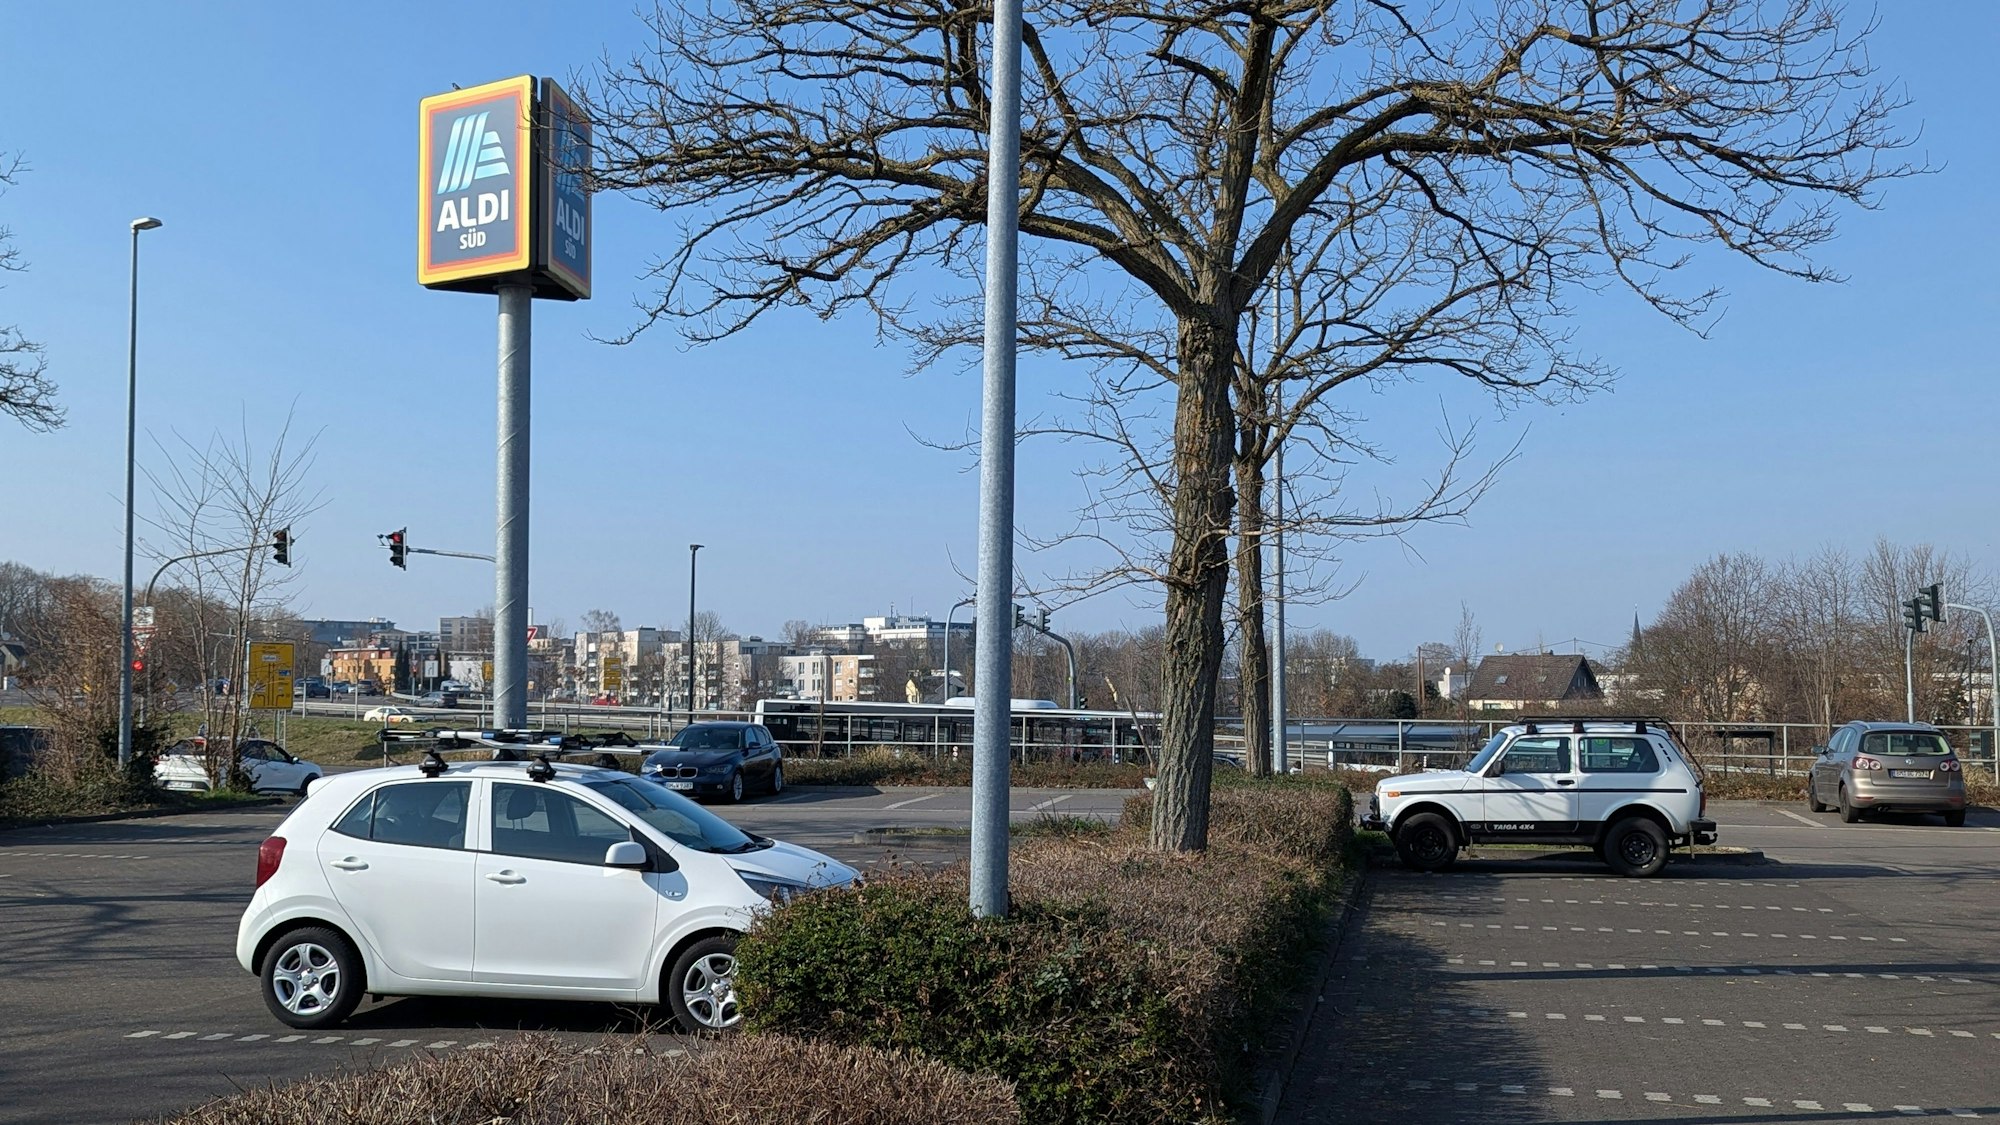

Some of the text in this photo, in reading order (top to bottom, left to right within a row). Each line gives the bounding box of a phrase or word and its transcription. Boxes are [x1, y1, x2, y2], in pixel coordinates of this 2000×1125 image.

[437, 189, 509, 232] ALDI
[556, 197, 585, 246] ALDI
[459, 228, 487, 250] SÜD
